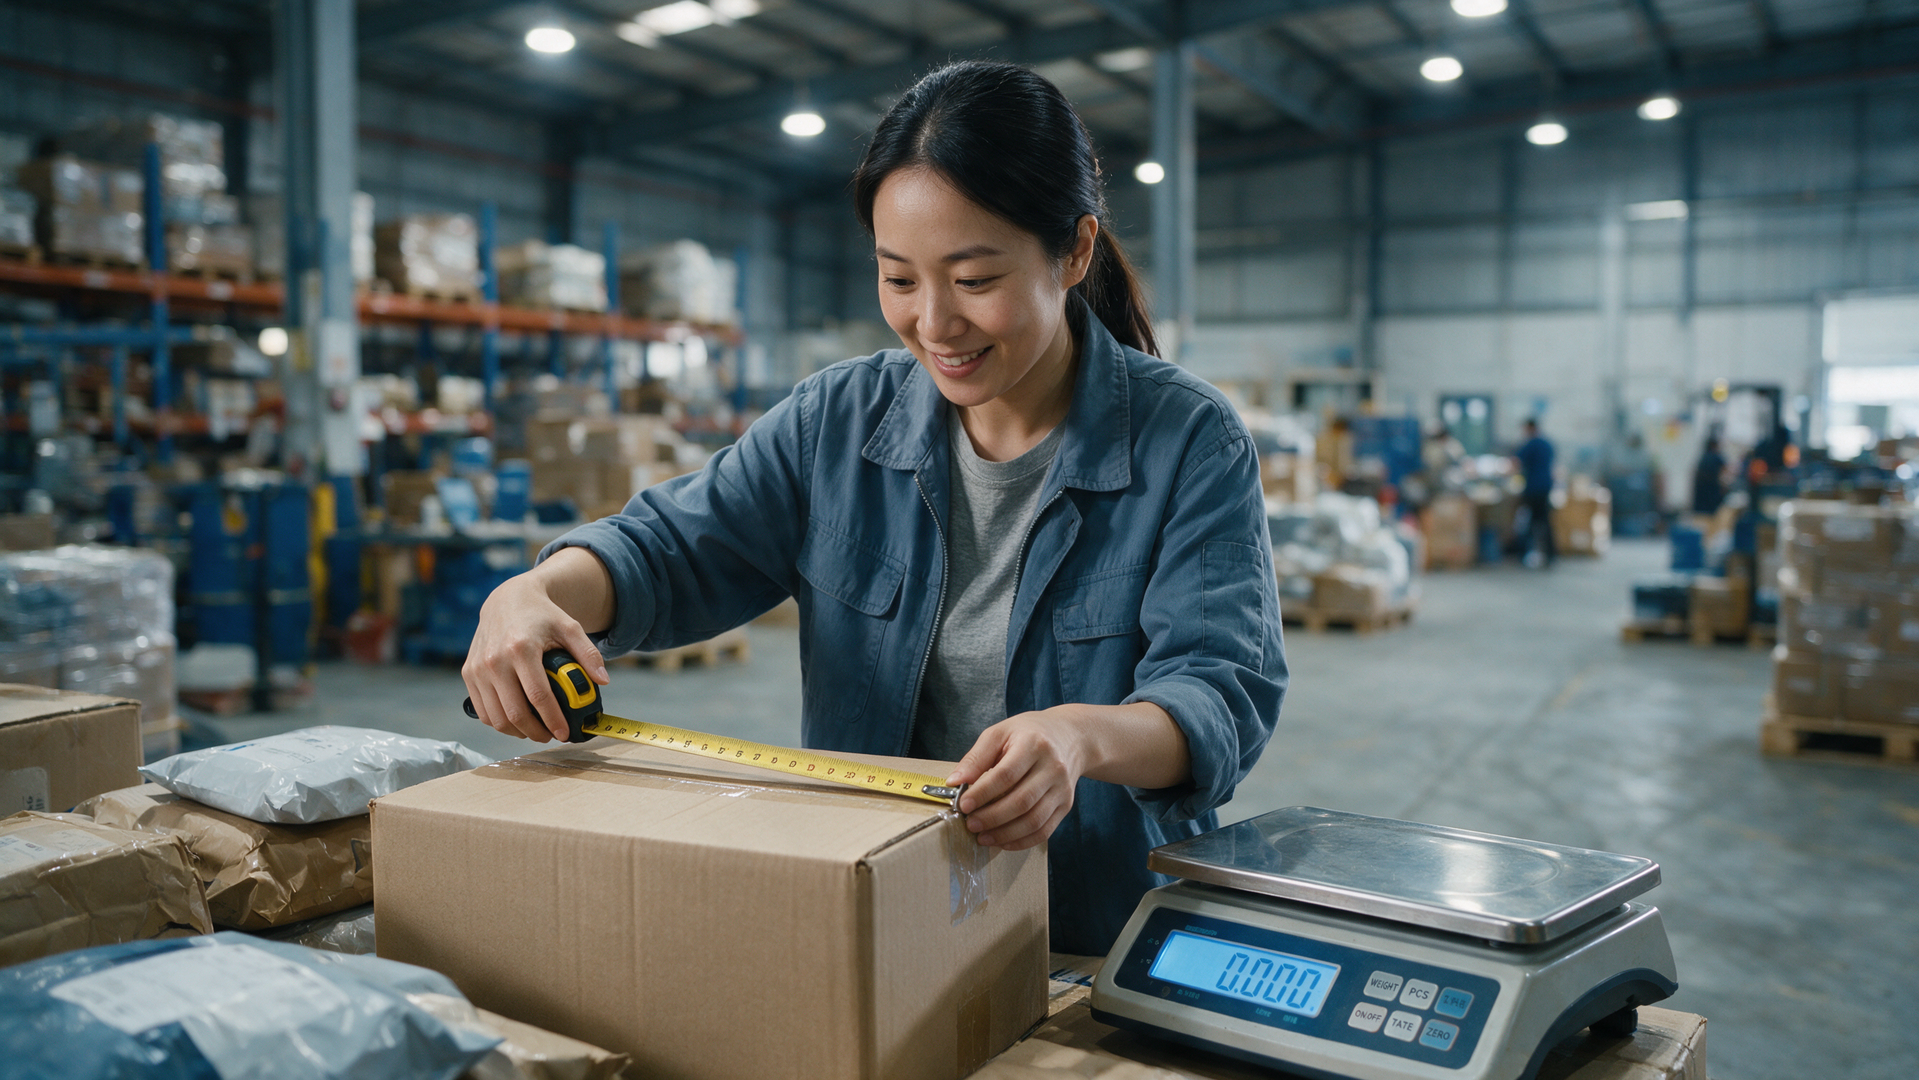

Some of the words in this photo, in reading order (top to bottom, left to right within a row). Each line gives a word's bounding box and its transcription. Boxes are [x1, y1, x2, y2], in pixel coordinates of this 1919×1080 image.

[1370, 978, 1399, 991] WEIGHT
[1408, 987, 1430, 1000] PCS
[1392, 1018, 1414, 1031] TATE
[1426, 1027, 1450, 1041] ZERO
